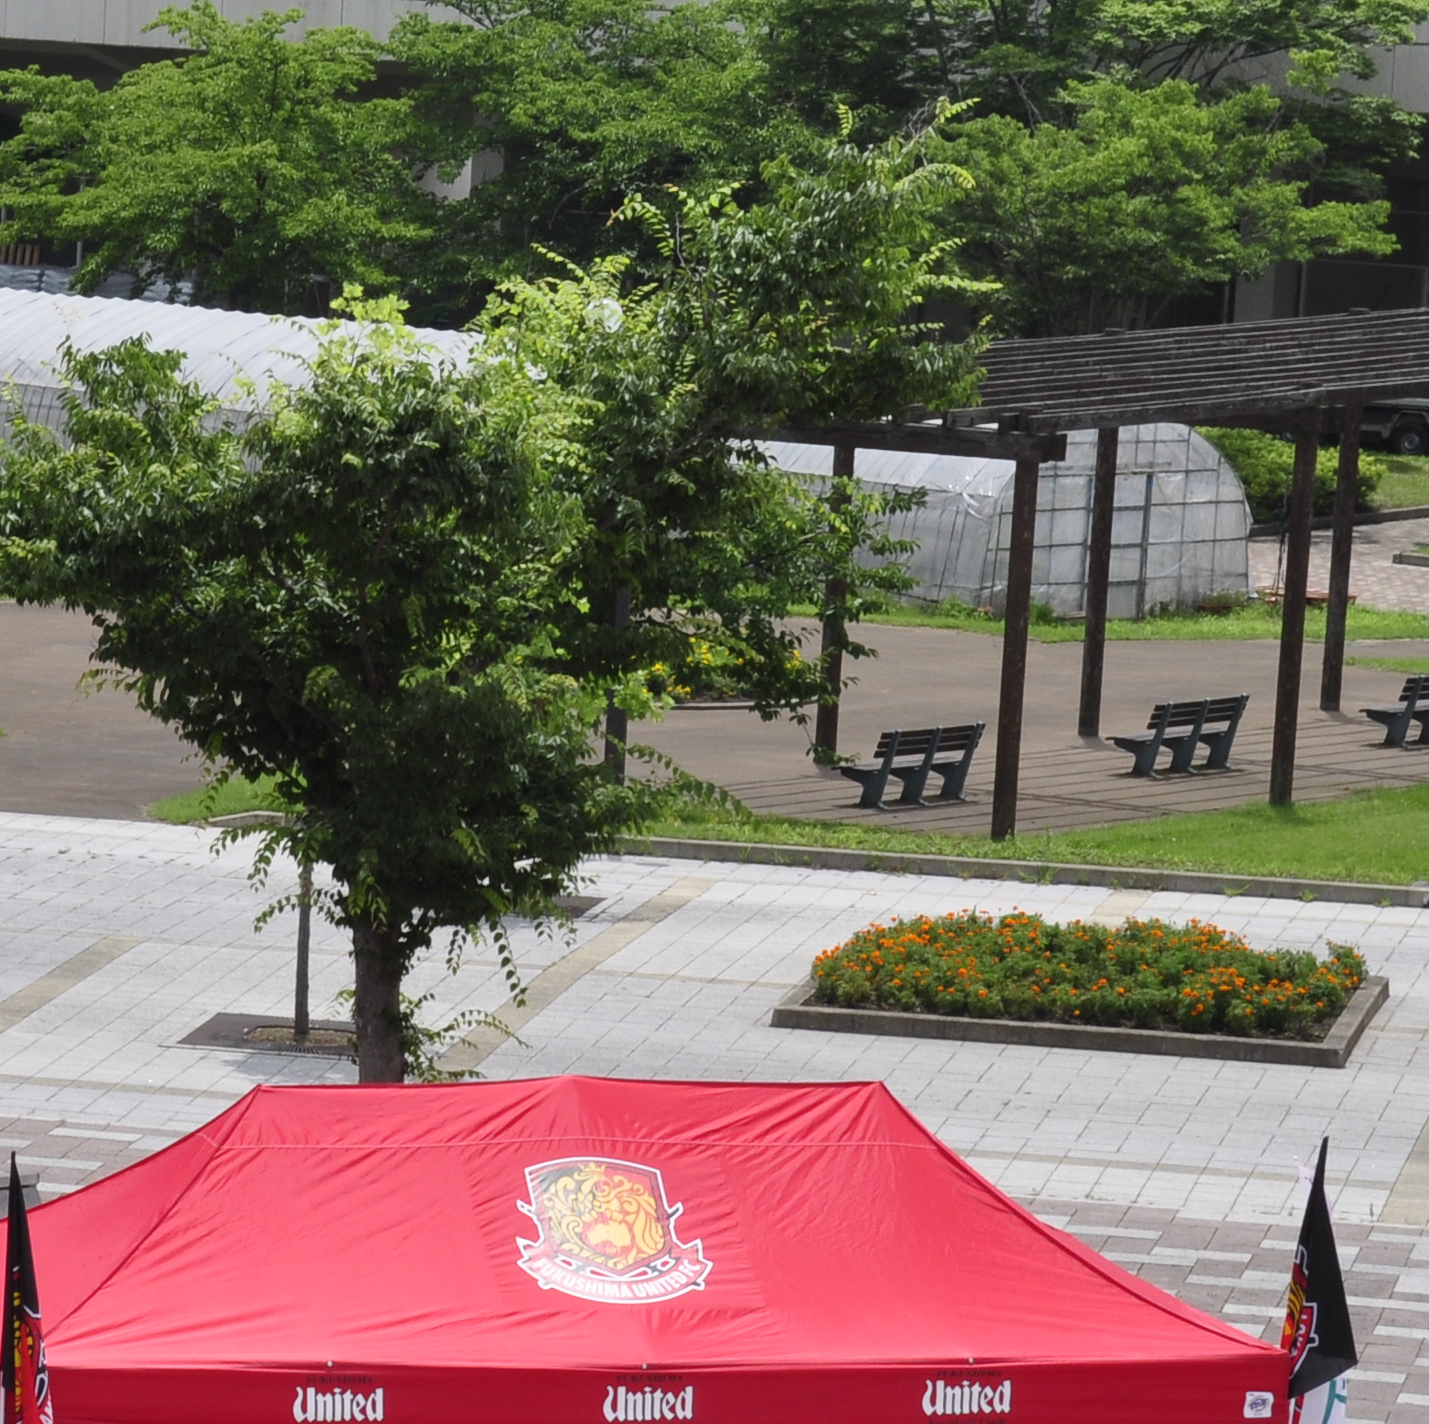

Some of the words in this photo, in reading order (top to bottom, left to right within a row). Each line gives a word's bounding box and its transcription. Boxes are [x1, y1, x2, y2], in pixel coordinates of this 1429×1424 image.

[532, 1258, 630, 1298] FUKUSHIMA
[633, 1271, 688, 1298] UNITED
[679, 1258, 701, 1277] FC
[292, 1386, 385, 1423] United
[602, 1384, 694, 1422] United
[922, 1379, 1012, 1416] United
